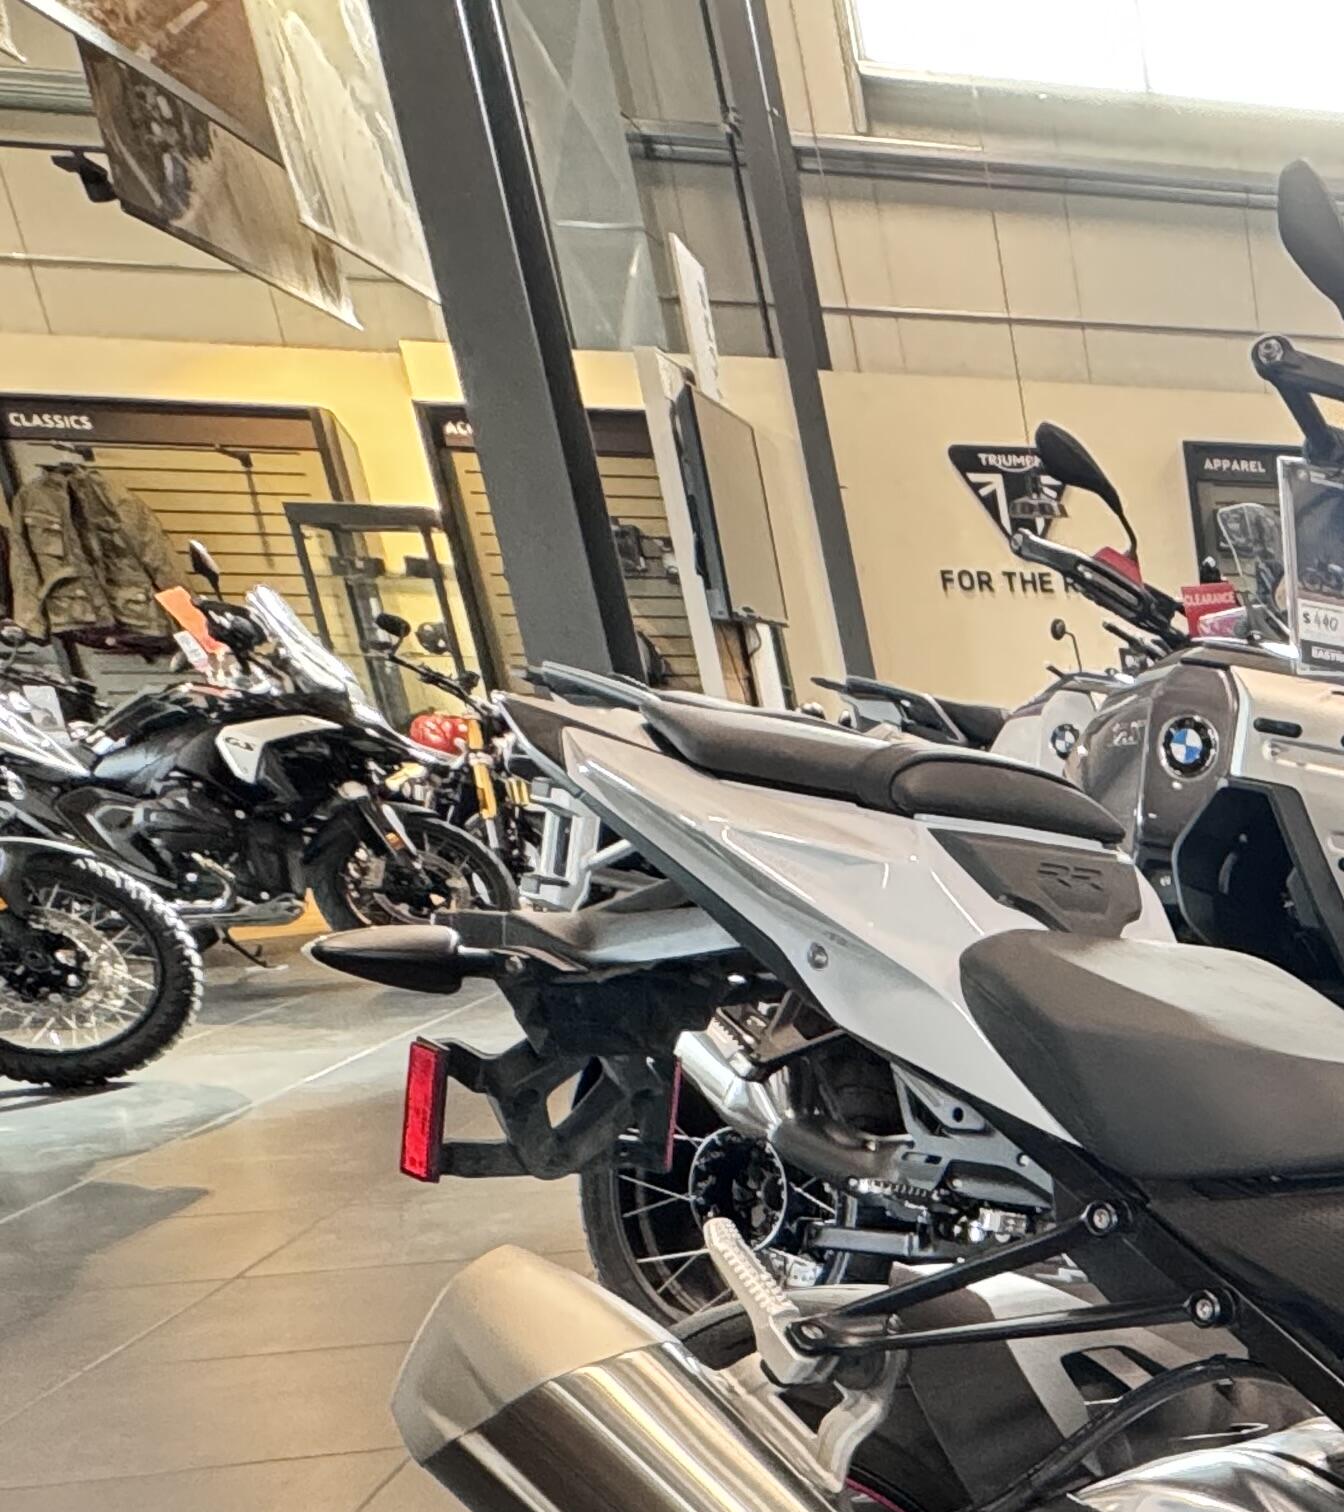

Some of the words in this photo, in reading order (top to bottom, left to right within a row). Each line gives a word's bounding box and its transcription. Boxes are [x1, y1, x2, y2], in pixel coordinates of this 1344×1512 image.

[8, 412, 94, 430] CLASSICS
[1204, 458, 1266, 473] APPAREL
[940, 569, 995, 593] FOR
[1002, 571, 1055, 594] THE
